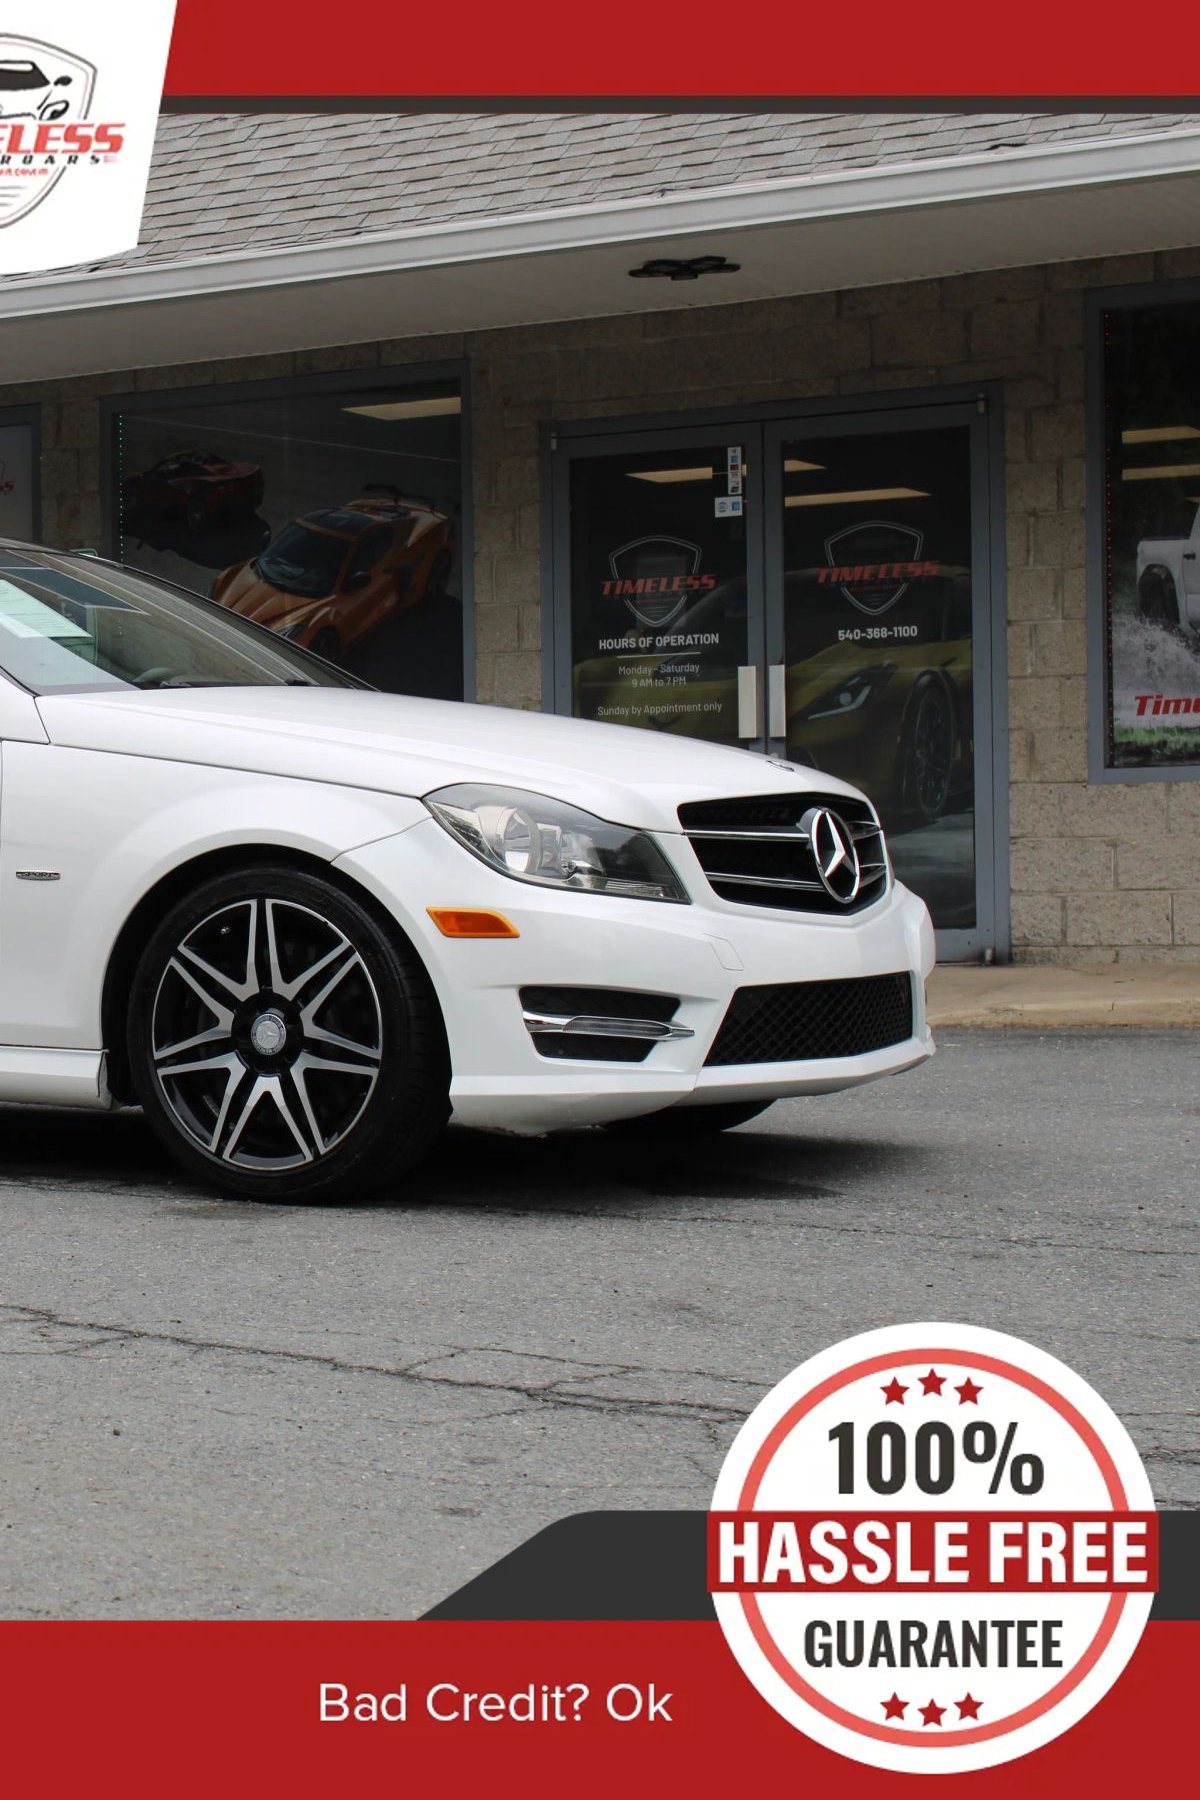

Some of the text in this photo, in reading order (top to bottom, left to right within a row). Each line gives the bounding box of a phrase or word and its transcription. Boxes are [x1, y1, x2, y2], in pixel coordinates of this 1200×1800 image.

[817, 560, 941, 584] TIMELESS
[600, 574, 717, 596] TIMELESS
[837, 625, 918, 641] 540-368-1100
[599, 633, 719, 650] HOURS OF OPERATION
[618, 666, 653, 676] Monday
[660, 663, 700, 674] Saturday
[631, 676, 686, 688] 9 AM to 7 PM
[597, 702, 722, 717] Sunday by Appointment only
